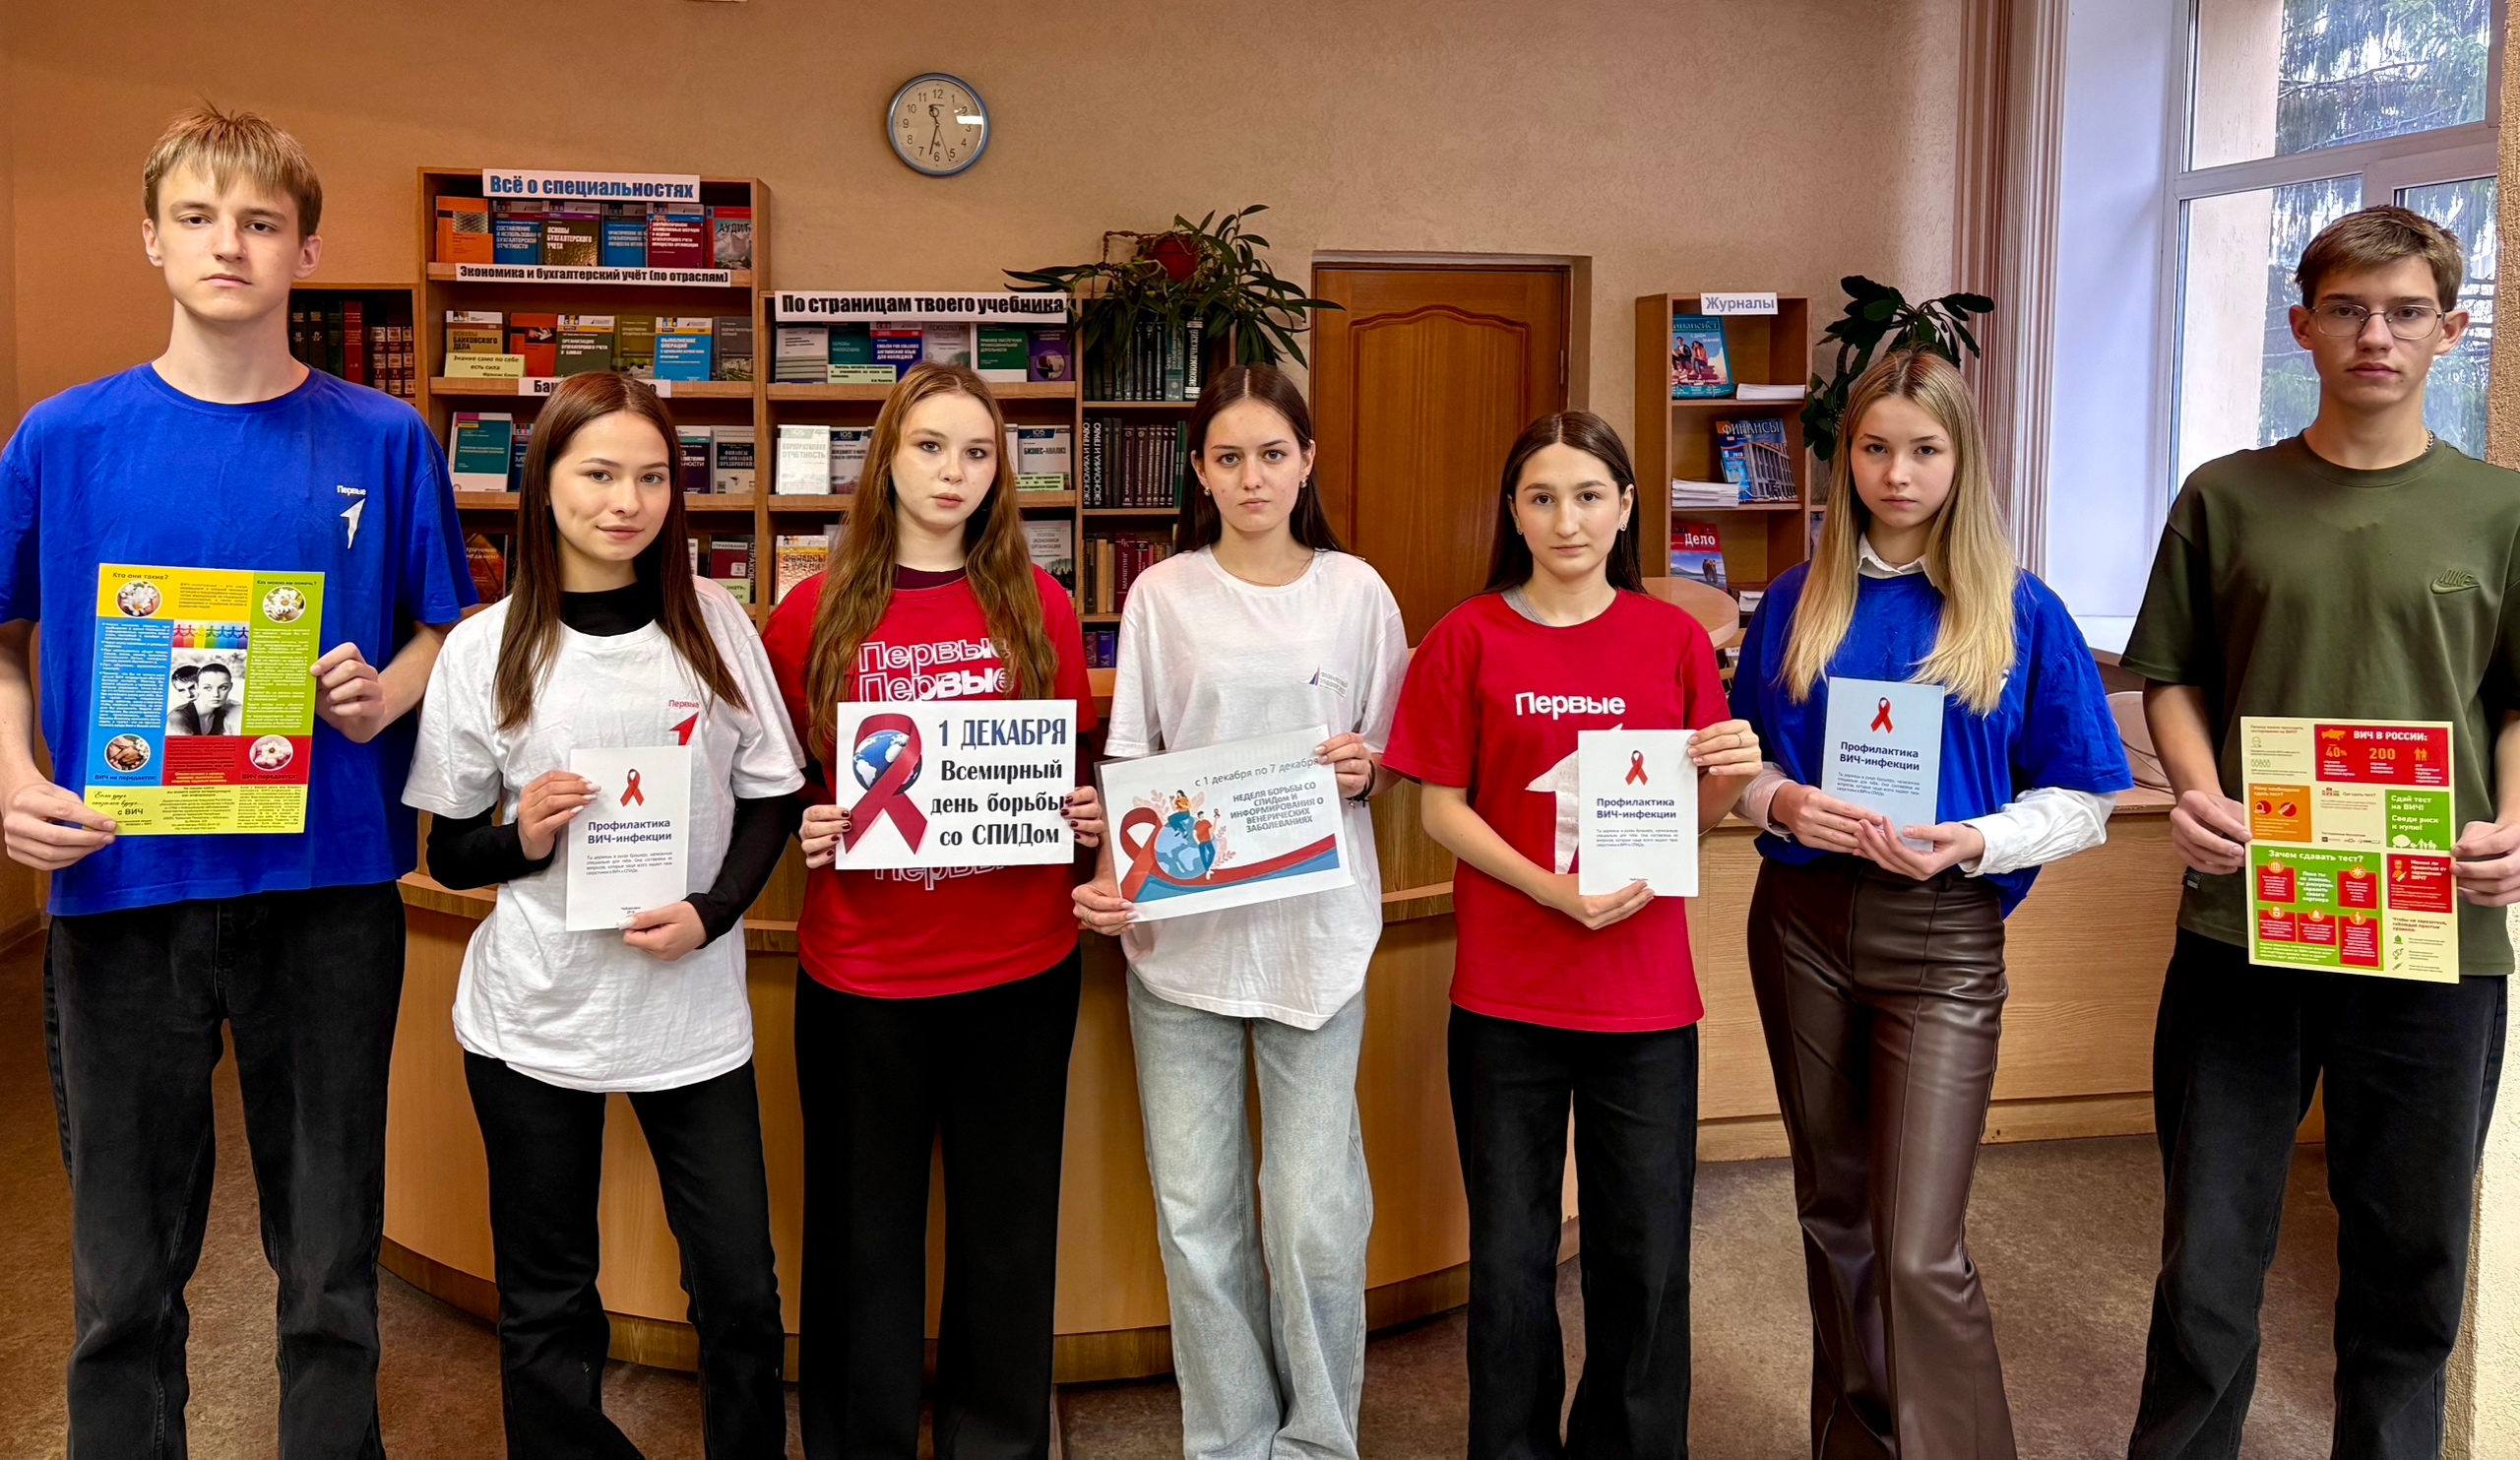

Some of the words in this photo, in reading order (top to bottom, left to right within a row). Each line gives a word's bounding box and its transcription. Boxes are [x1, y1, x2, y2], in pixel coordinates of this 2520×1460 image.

[917, 93, 927, 102] 11
[932, 90, 943, 99] 12
[951, 95, 955, 104] 1
[907, 103, 916, 114] 10
[903, 119, 909, 128] 9
[908, 134, 914, 144] 8
[961, 138, 967, 148] 4
[918, 146, 924, 156] 7
[933, 152, 939, 161] 6
[949, 148, 955, 159] 5
[490, 175, 524, 194] Всё
[528, 179, 537, 194] о
[542, 179, 694, 198] специальностях
[460, 266, 525, 280] Экономика
[527, 268, 536, 280] и
[537, 267, 620, 283] бухгалтерский
[622, 270, 648, 282] учёт
[650, 270, 667, 282] (по
[669, 272, 728, 284] отраслям)
[782, 295, 805, 313] По
[809, 296, 912, 315] страницам
[914, 297, 975, 313] твоего
[976, 295, 1063, 314] учебника
[1705, 296, 1775, 311] Журналы
[1723, 421, 1780, 435] ФИНАНСЫ
[337, 484, 366, 496] Первые
[1684, 533, 1716, 547] Дело
[2439, 568, 2474, 588] NIKE
[668, 699, 700, 709] Первые
[1516, 691, 1626, 721] Первые
[938, 720, 948, 746] 1
[961, 719, 1067, 750] ДЕКАБРЯ
[2354, 730, 2373, 739] ВИЧ
[2376, 730, 2382, 739] В
[2386, 731, 2427, 741] РОССИИ:
[1841, 741, 1919, 758] Профилактика
[2325, 746, 2347, 758] 40%
[2368, 747, 2396, 760] 200
[1840, 753, 1920, 771] ВИЧ-инфекции
[941, 759, 1063, 785] Всемирный
[1212, 771, 1252, 786] декабря
[1255, 767, 1268, 776] по
[1270, 764, 1276, 773] 7
[1279, 757, 1319, 774] декабря
[1232, 790, 1267, 802] НЕДЕЛЯ
[1268, 785, 1302, 796] БОРЬБЫ
[930, 796, 978, 815] день
[987, 792, 1064, 817] борьбы
[1254, 795, 1290, 807] СПИДом
[1597, 797, 1675, 808] Профилактика
[1230, 798, 1315, 819] ИНФОРМИРОВАНИЯ
[1597, 809, 1676, 820] ВИЧ-инфекции
[1246, 807, 1310, 824] ВЕНЕРИЧЕСКИХ
[588, 819, 670, 833] Профилактика
[1246, 815, 1313, 833] ЗАБОЛЕВАНИЯХ
[588, 833, 672, 844] ВИЧ-инфекции
[939, 830, 963, 847] со
[973, 823, 1059, 847] СПИДом
[2268, 850, 2298, 858] Зачем
[2300, 853, 2336, 861] сдавать
